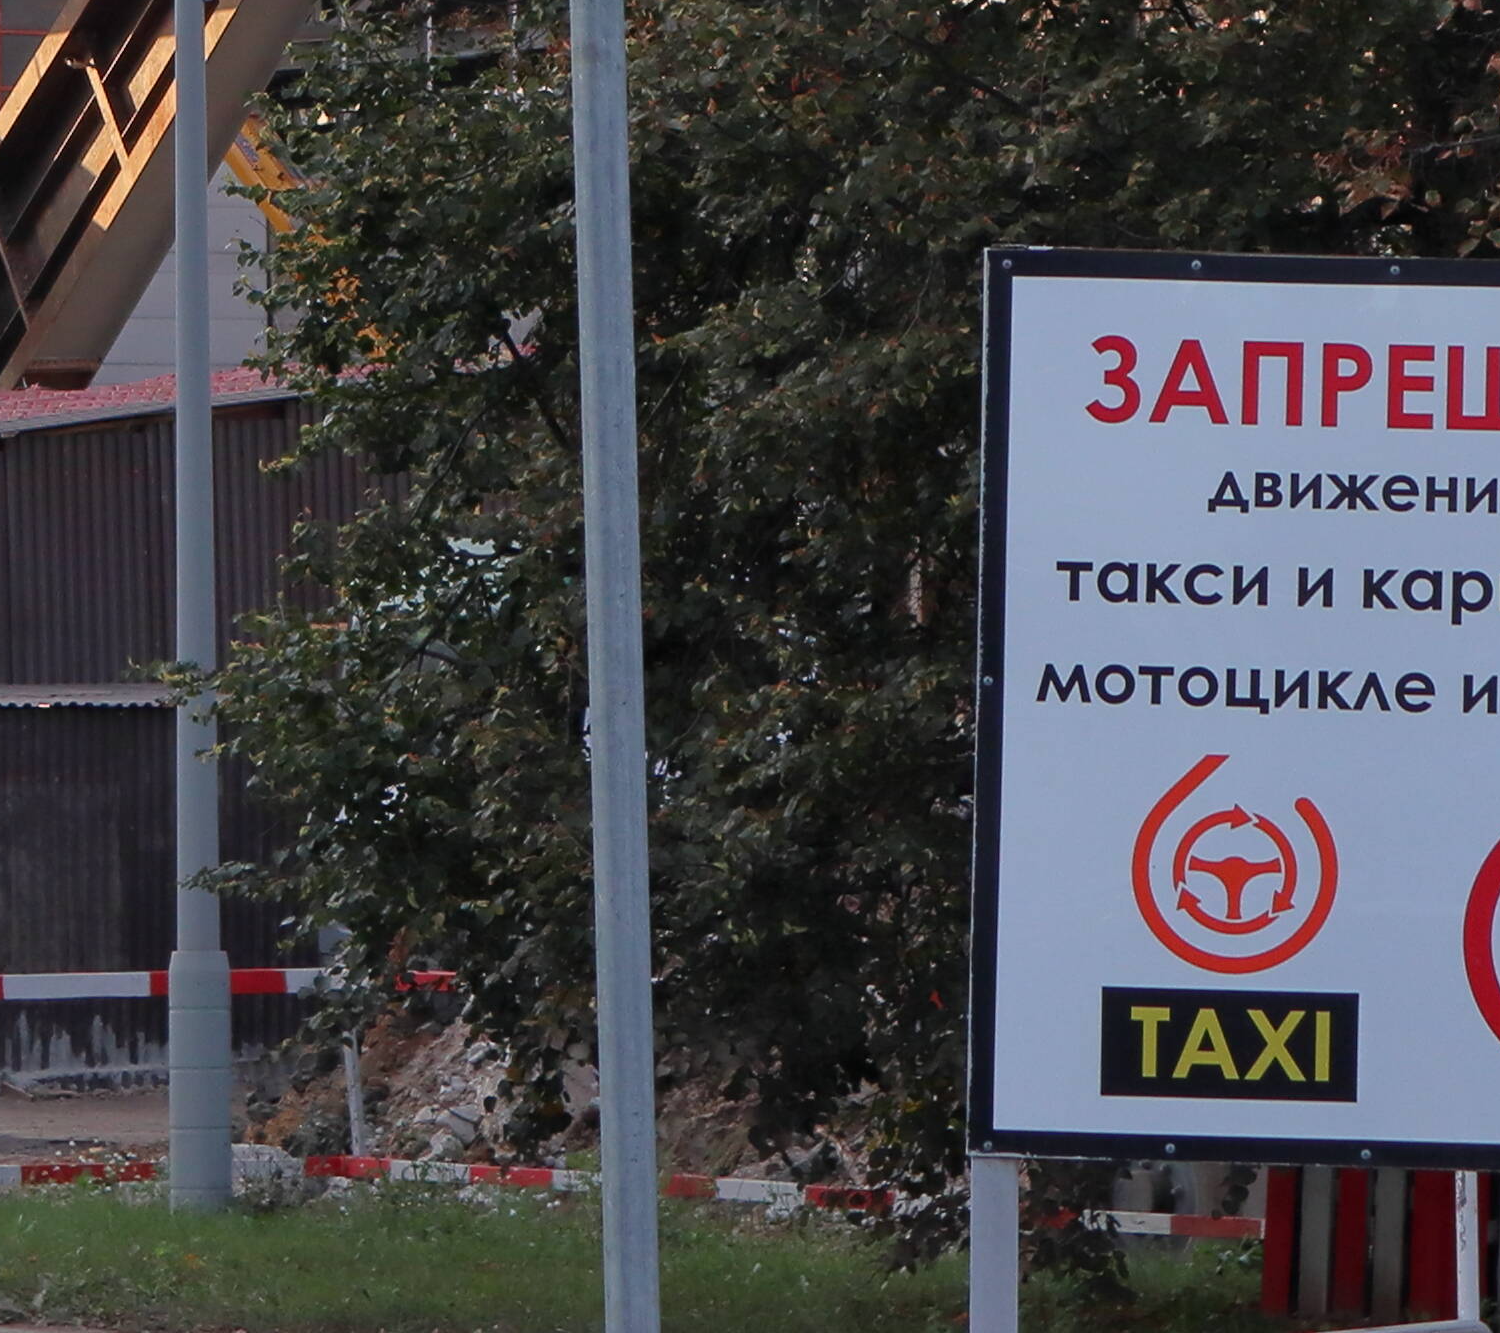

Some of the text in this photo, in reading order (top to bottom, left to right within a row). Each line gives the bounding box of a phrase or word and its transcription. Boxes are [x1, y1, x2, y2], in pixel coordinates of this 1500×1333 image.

[1056, 559, 1269, 607] такси
[1297, 565, 1334, 608] и
[1036, 662, 1436, 715] мотоцикле
[1462, 673, 1499, 715] и
[1131, 1006, 1330, 1082] TAXI
